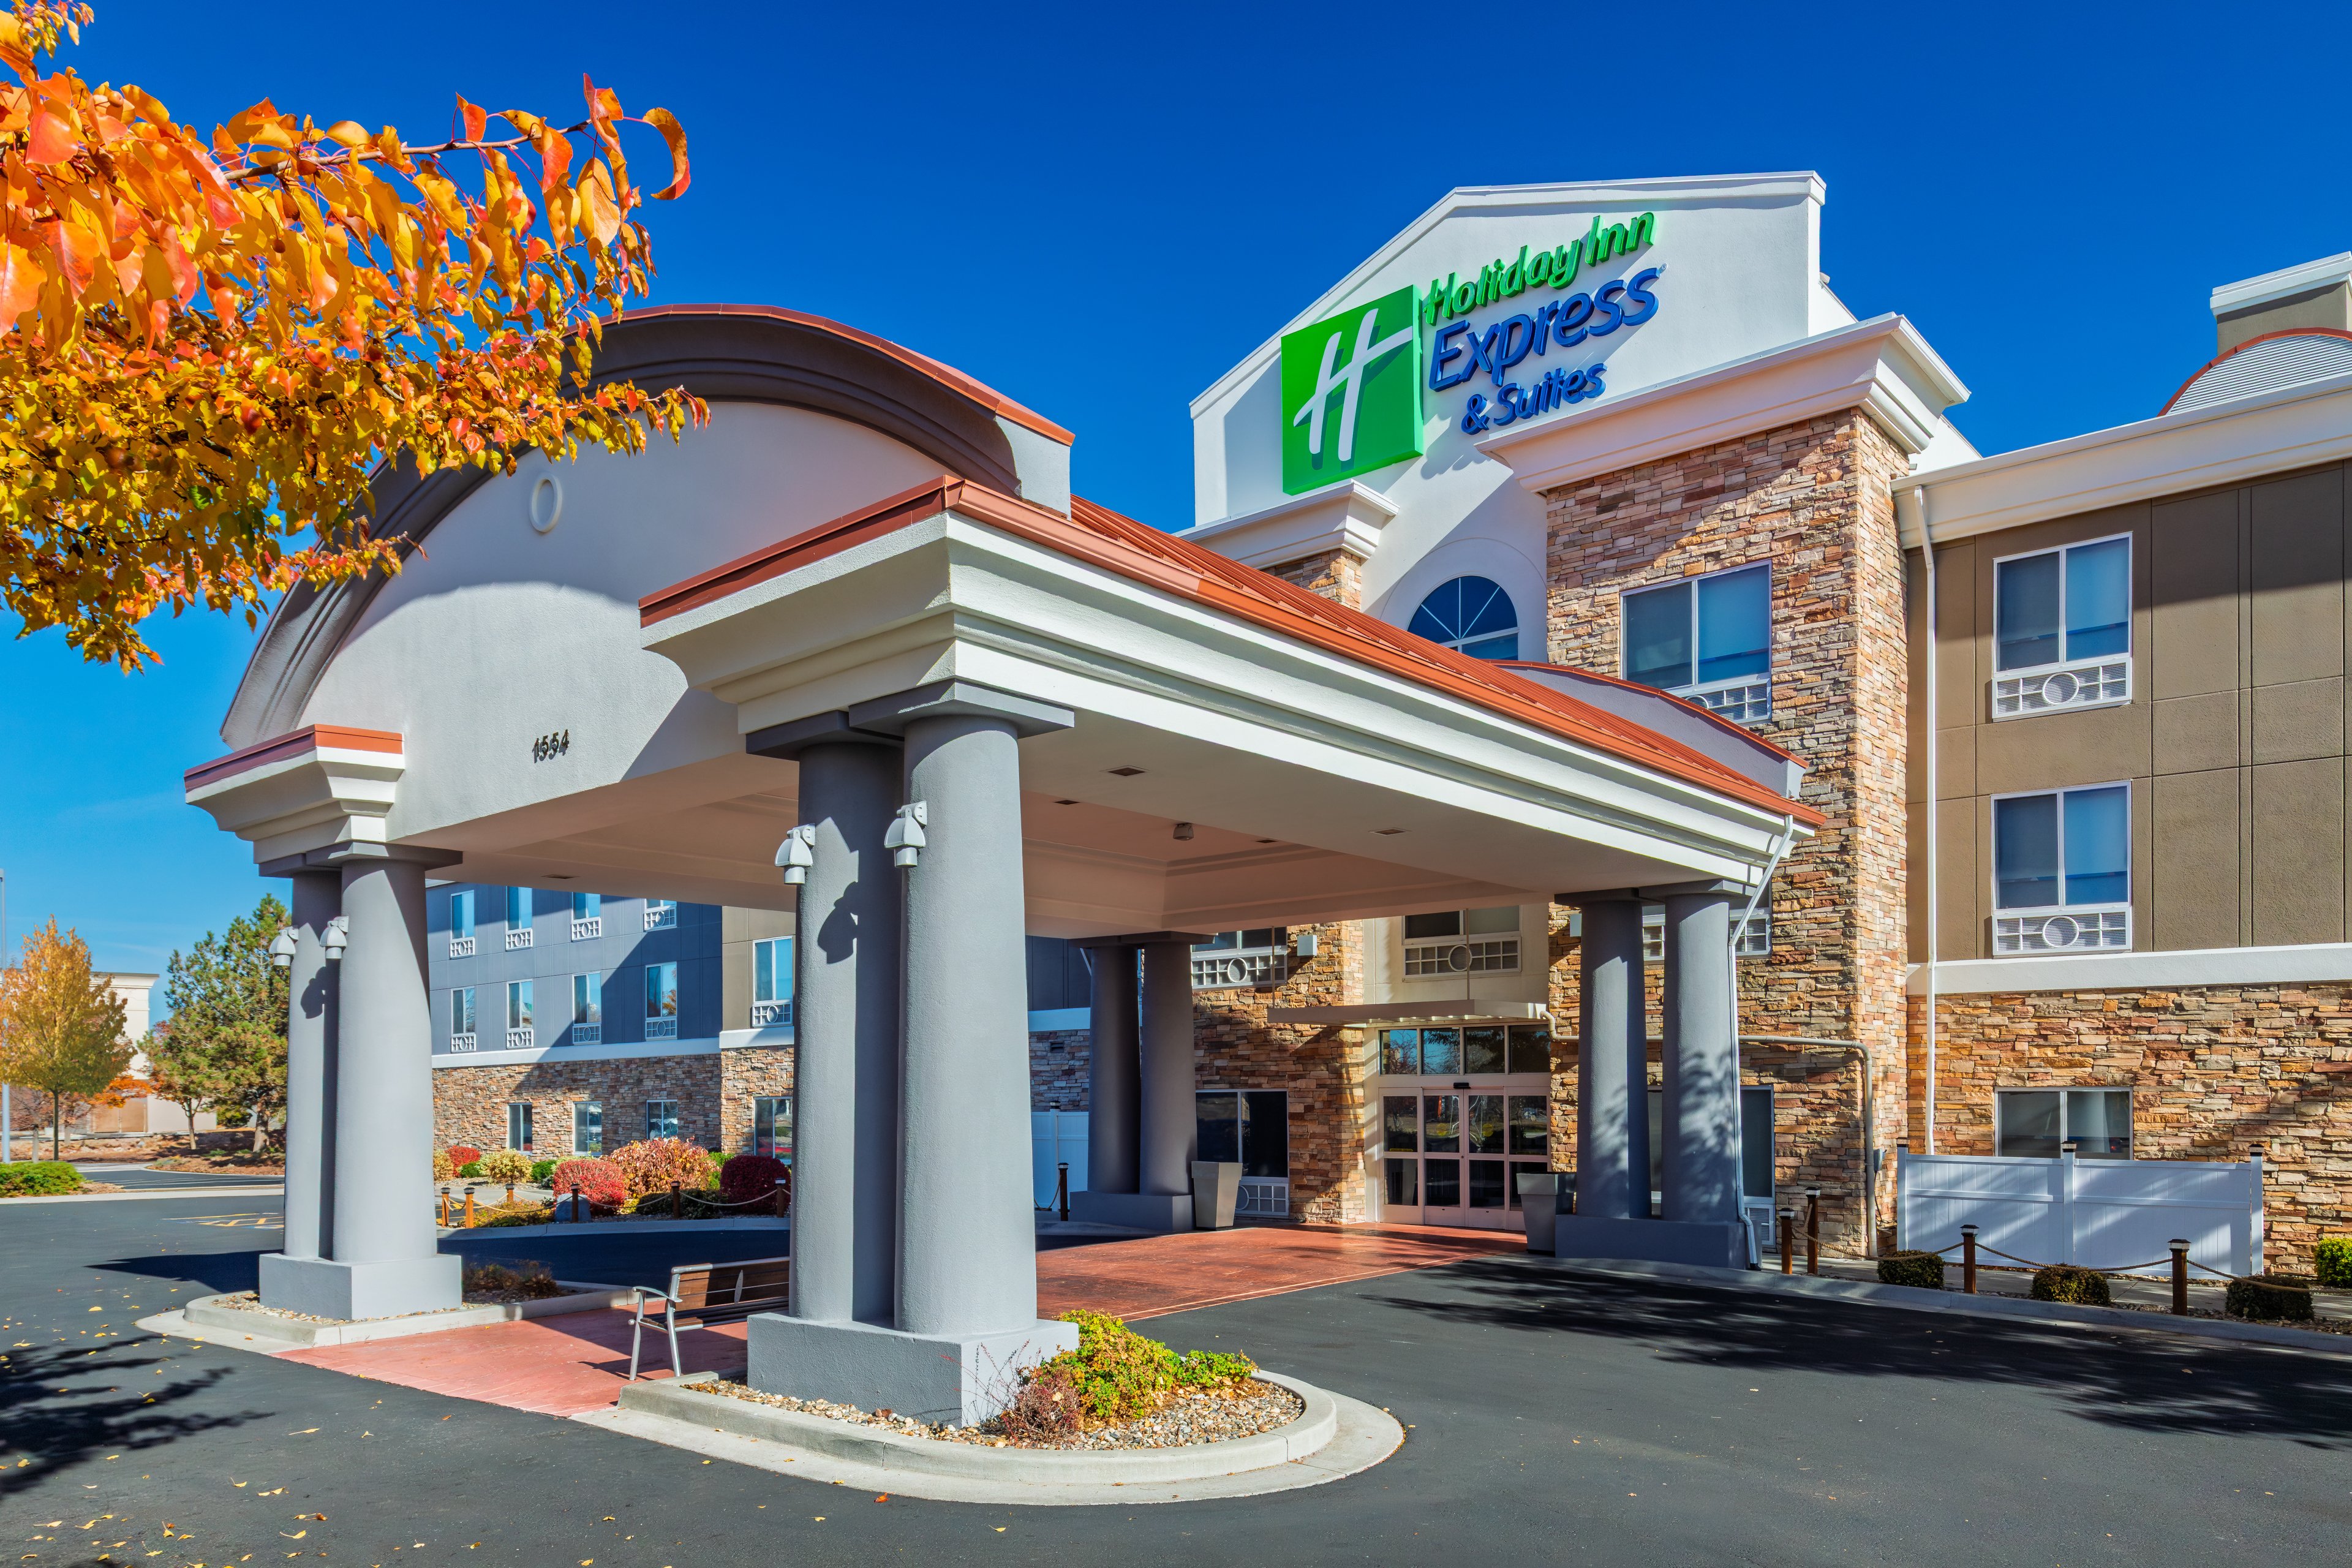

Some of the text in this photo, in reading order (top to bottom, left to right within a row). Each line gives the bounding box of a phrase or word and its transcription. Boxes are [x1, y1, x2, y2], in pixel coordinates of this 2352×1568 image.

[1423, 212, 1658, 325] Holiday Inn
[1429, 267, 1660, 392] Express
[1461, 363, 1607, 435] & Suites
